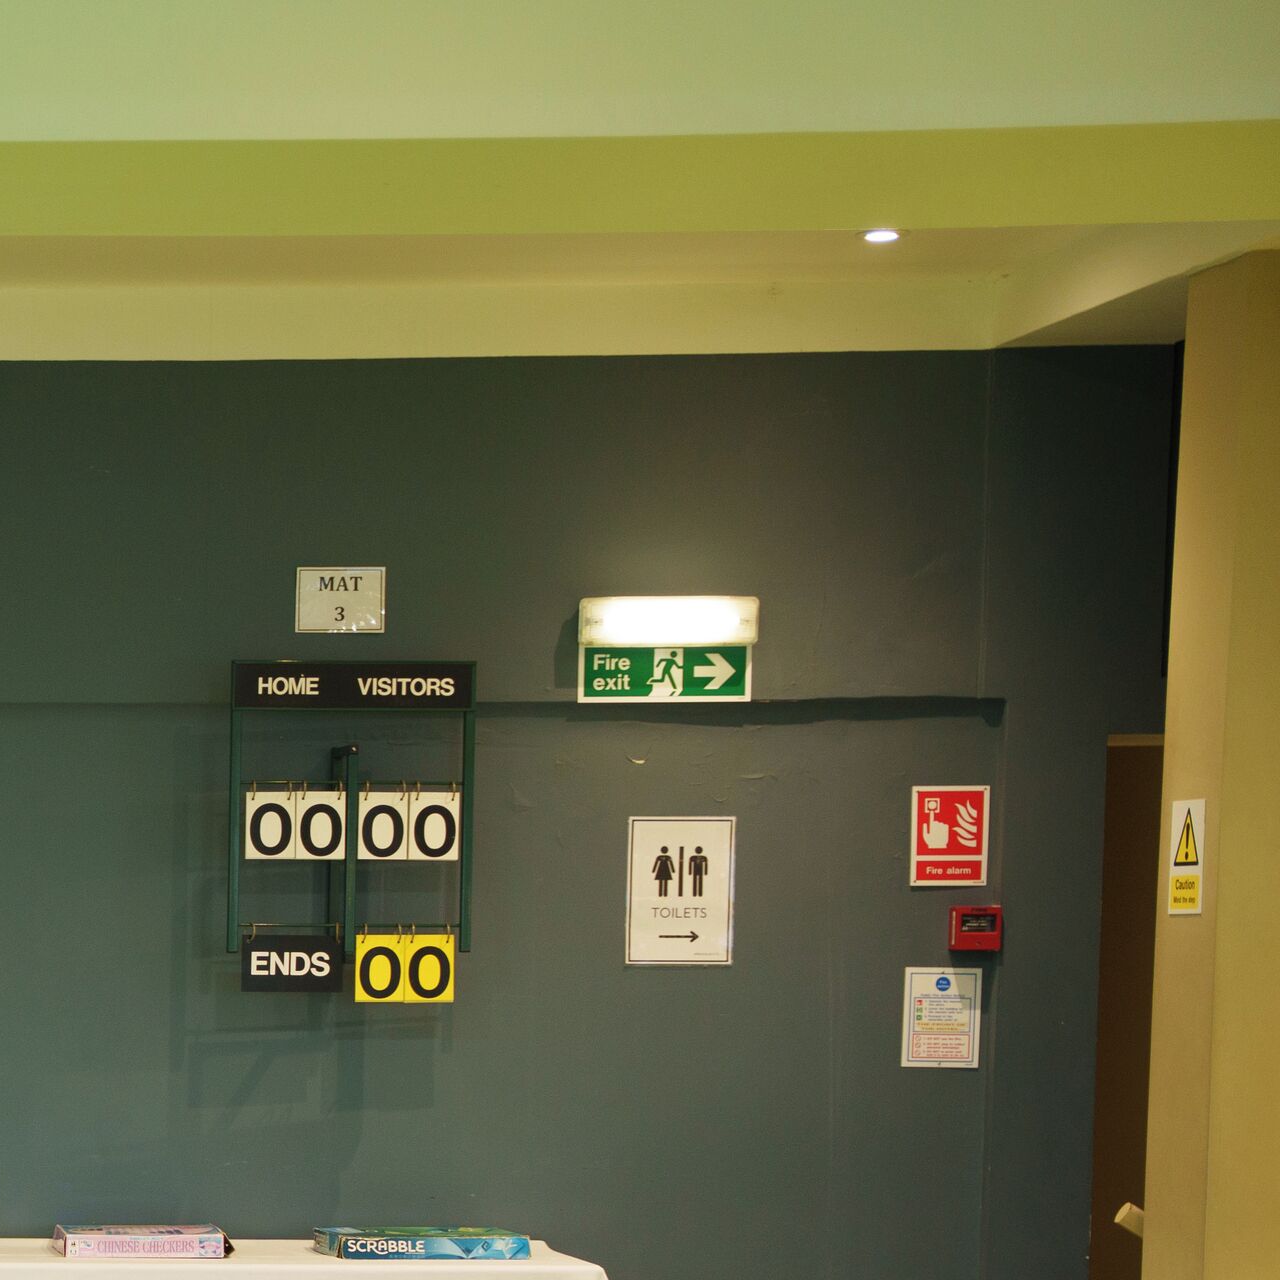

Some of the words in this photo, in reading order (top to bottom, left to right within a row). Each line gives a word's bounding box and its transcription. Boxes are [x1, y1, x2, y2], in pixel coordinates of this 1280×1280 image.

[318, 576, 363, 592] MAT
[334, 606, 345, 622] 3
[592, 654, 631, 672] Fire
[257, 676, 320, 695] HOME
[357, 677, 455, 696] VISITORS
[592, 674, 631, 692] exit
[250, 803, 342, 857] 00
[362, 804, 456, 858] 00
[926, 866, 943, 875] Fire
[946, 866, 971, 875] alarm
[1175, 879, 1196, 890] Caution
[651, 907, 707, 919] TOILETS
[250, 951, 331, 977] ENDS
[359, 946, 451, 999] 00
[96, 1240, 140, 1253] CHINESE
[142, 1240, 195, 1253] CHECKERS
[347, 1240, 425, 1255] SCRABBLE
